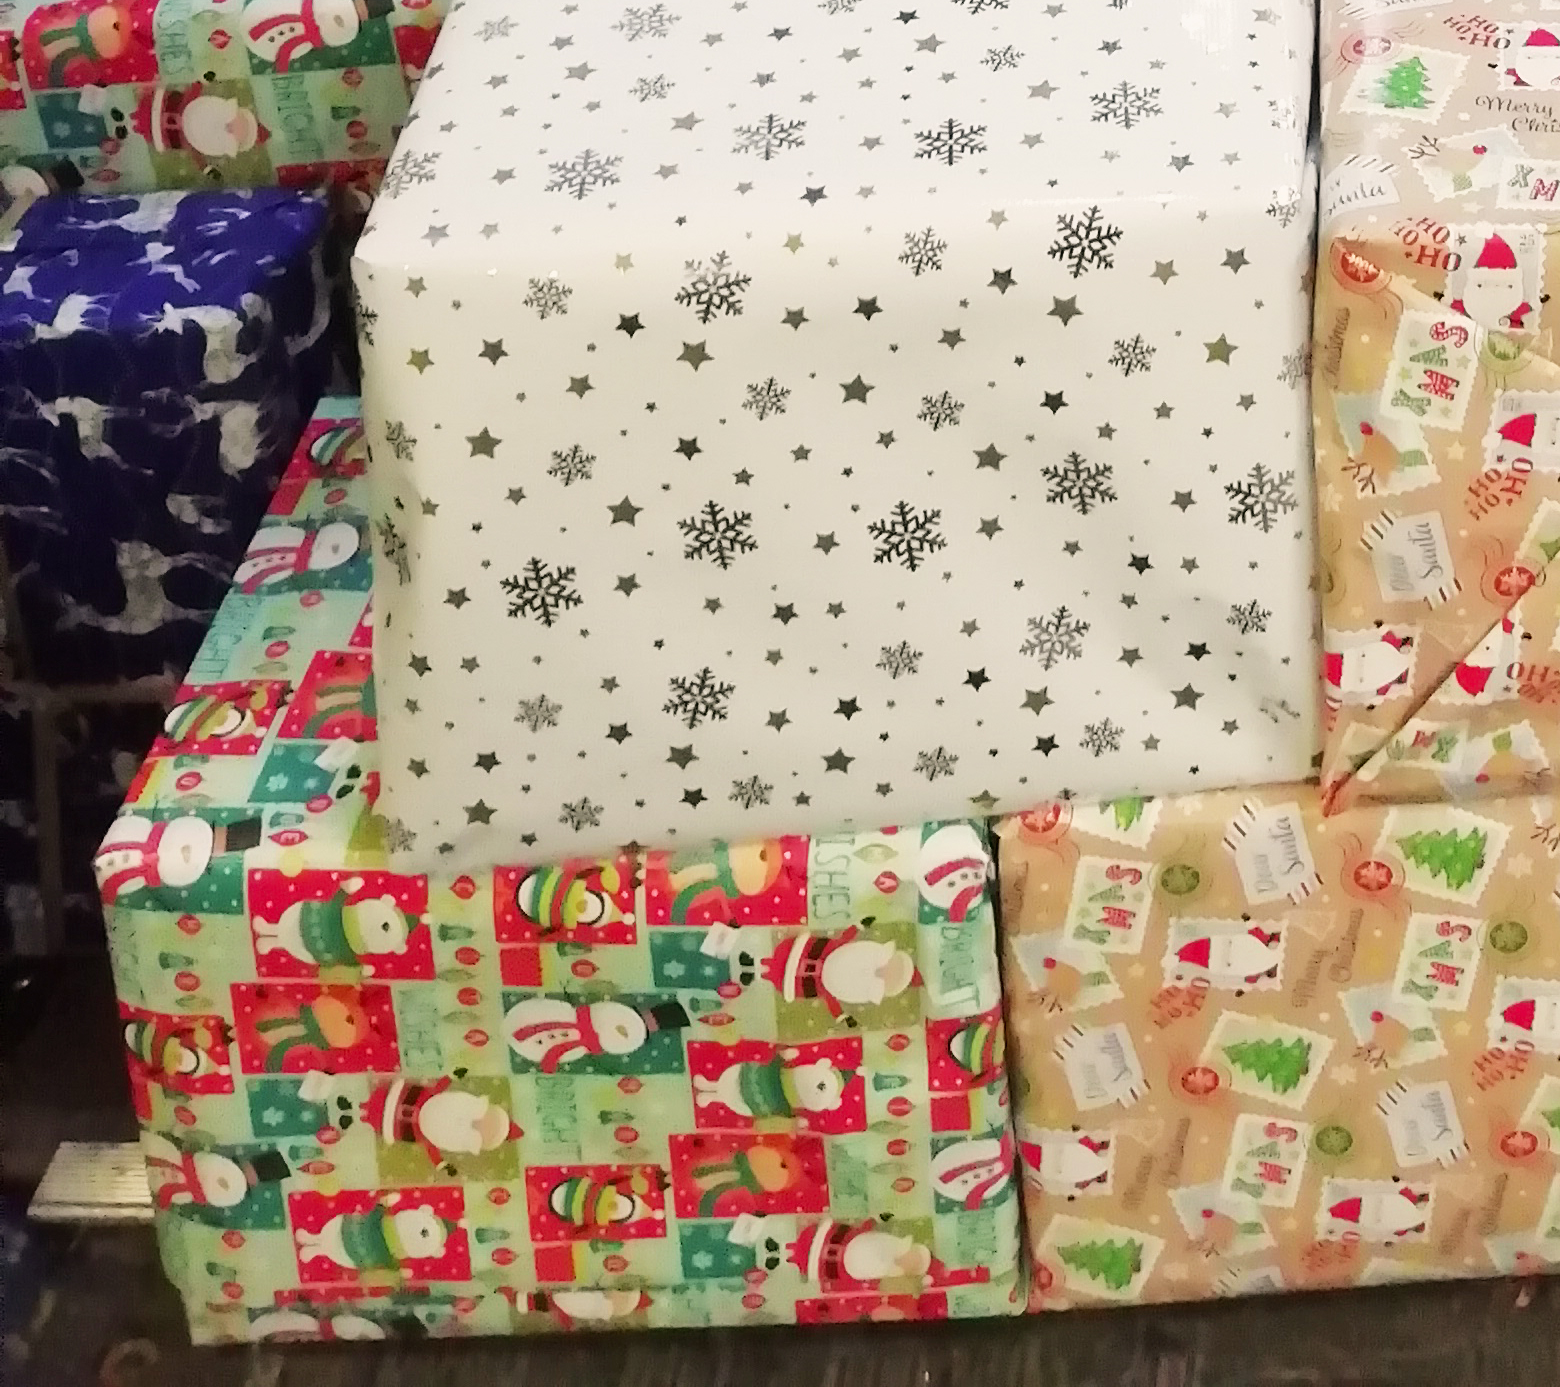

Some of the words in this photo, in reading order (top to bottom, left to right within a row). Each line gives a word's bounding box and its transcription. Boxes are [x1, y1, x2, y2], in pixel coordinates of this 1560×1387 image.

[1475, 95, 1553, 117] Merry
[1414, 247, 1461, 272] HO
[1390, 321, 1469, 417] XMAS
[812, 836, 853, 921] ISHES
[1072, 864, 1143, 945] XMAS
